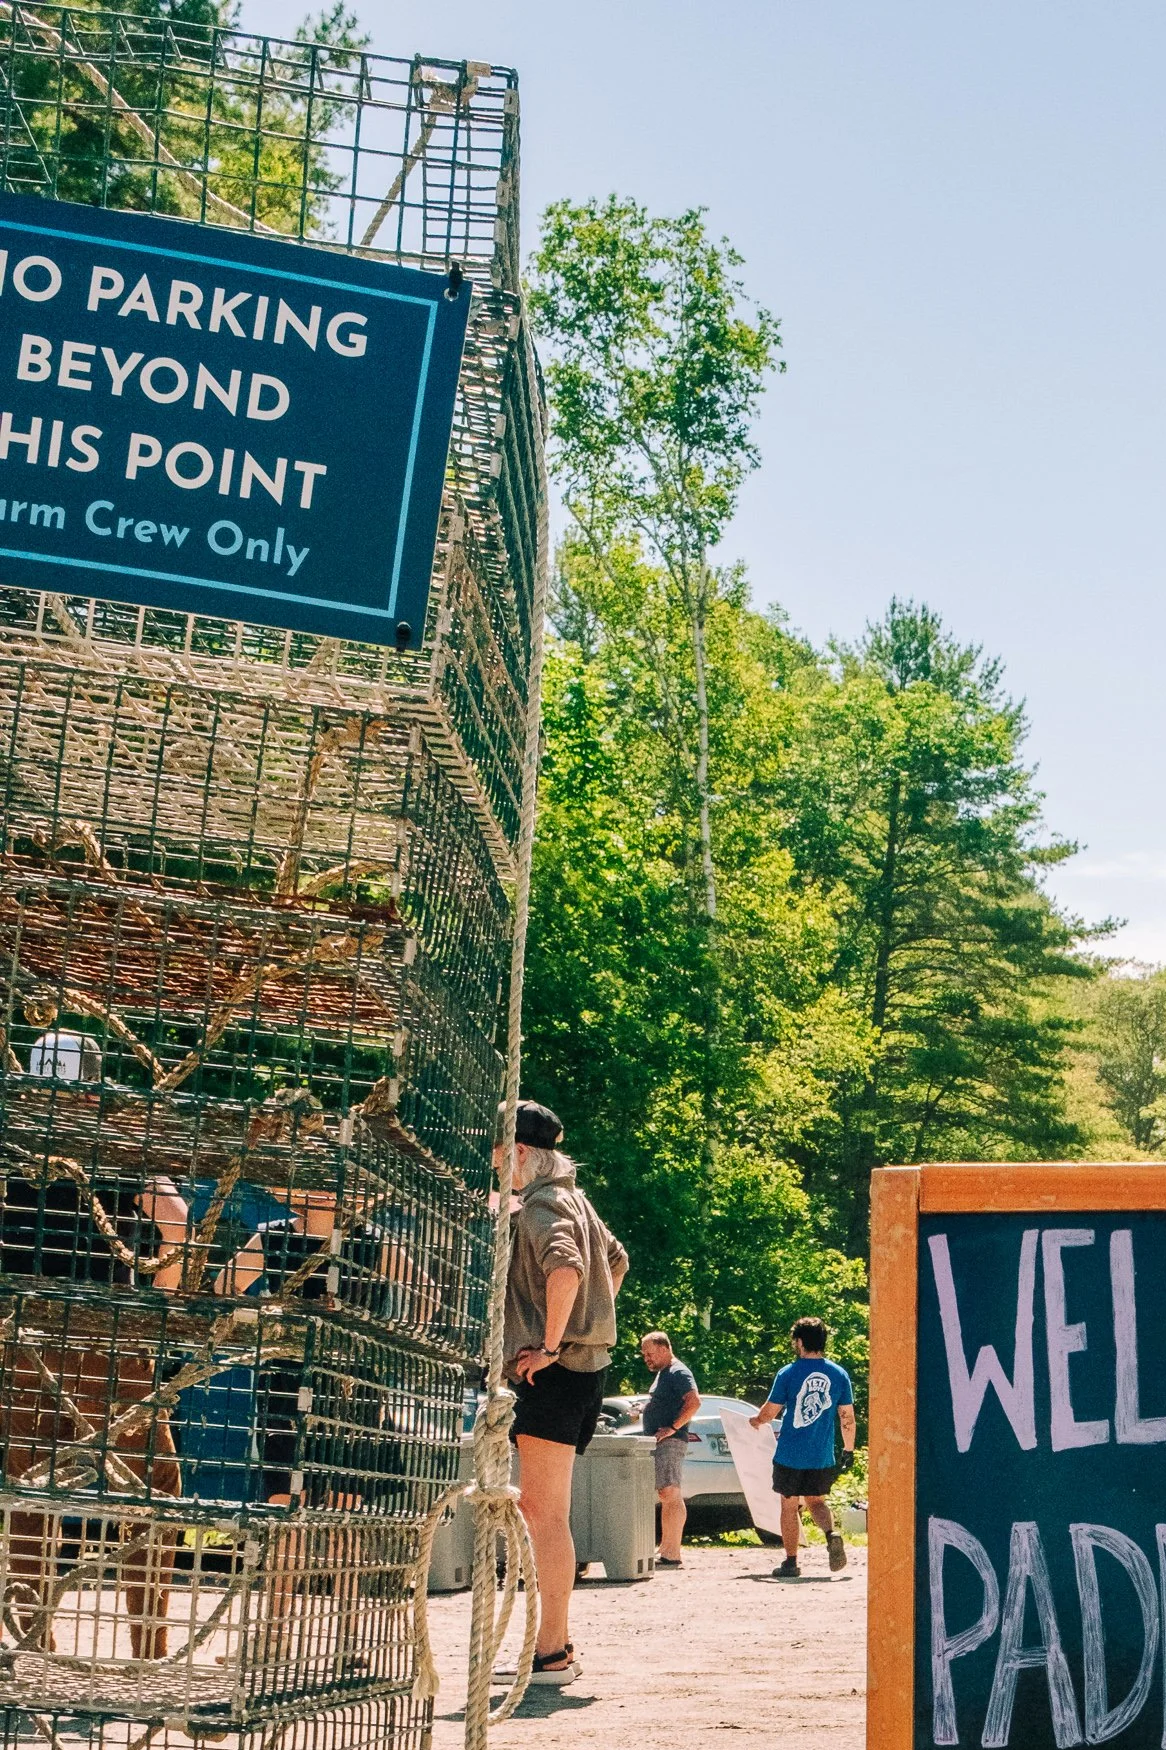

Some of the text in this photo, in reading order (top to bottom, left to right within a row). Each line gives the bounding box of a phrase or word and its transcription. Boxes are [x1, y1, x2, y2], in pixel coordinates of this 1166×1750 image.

[0, 249, 368, 358] O PARKING
[16, 333, 290, 421] BEYOND
[125, 432, 328, 509] POINT
[85, 499, 191, 549] Crew
[206, 519, 310, 577] Only
[806, 1378, 827, 1388] YETI
